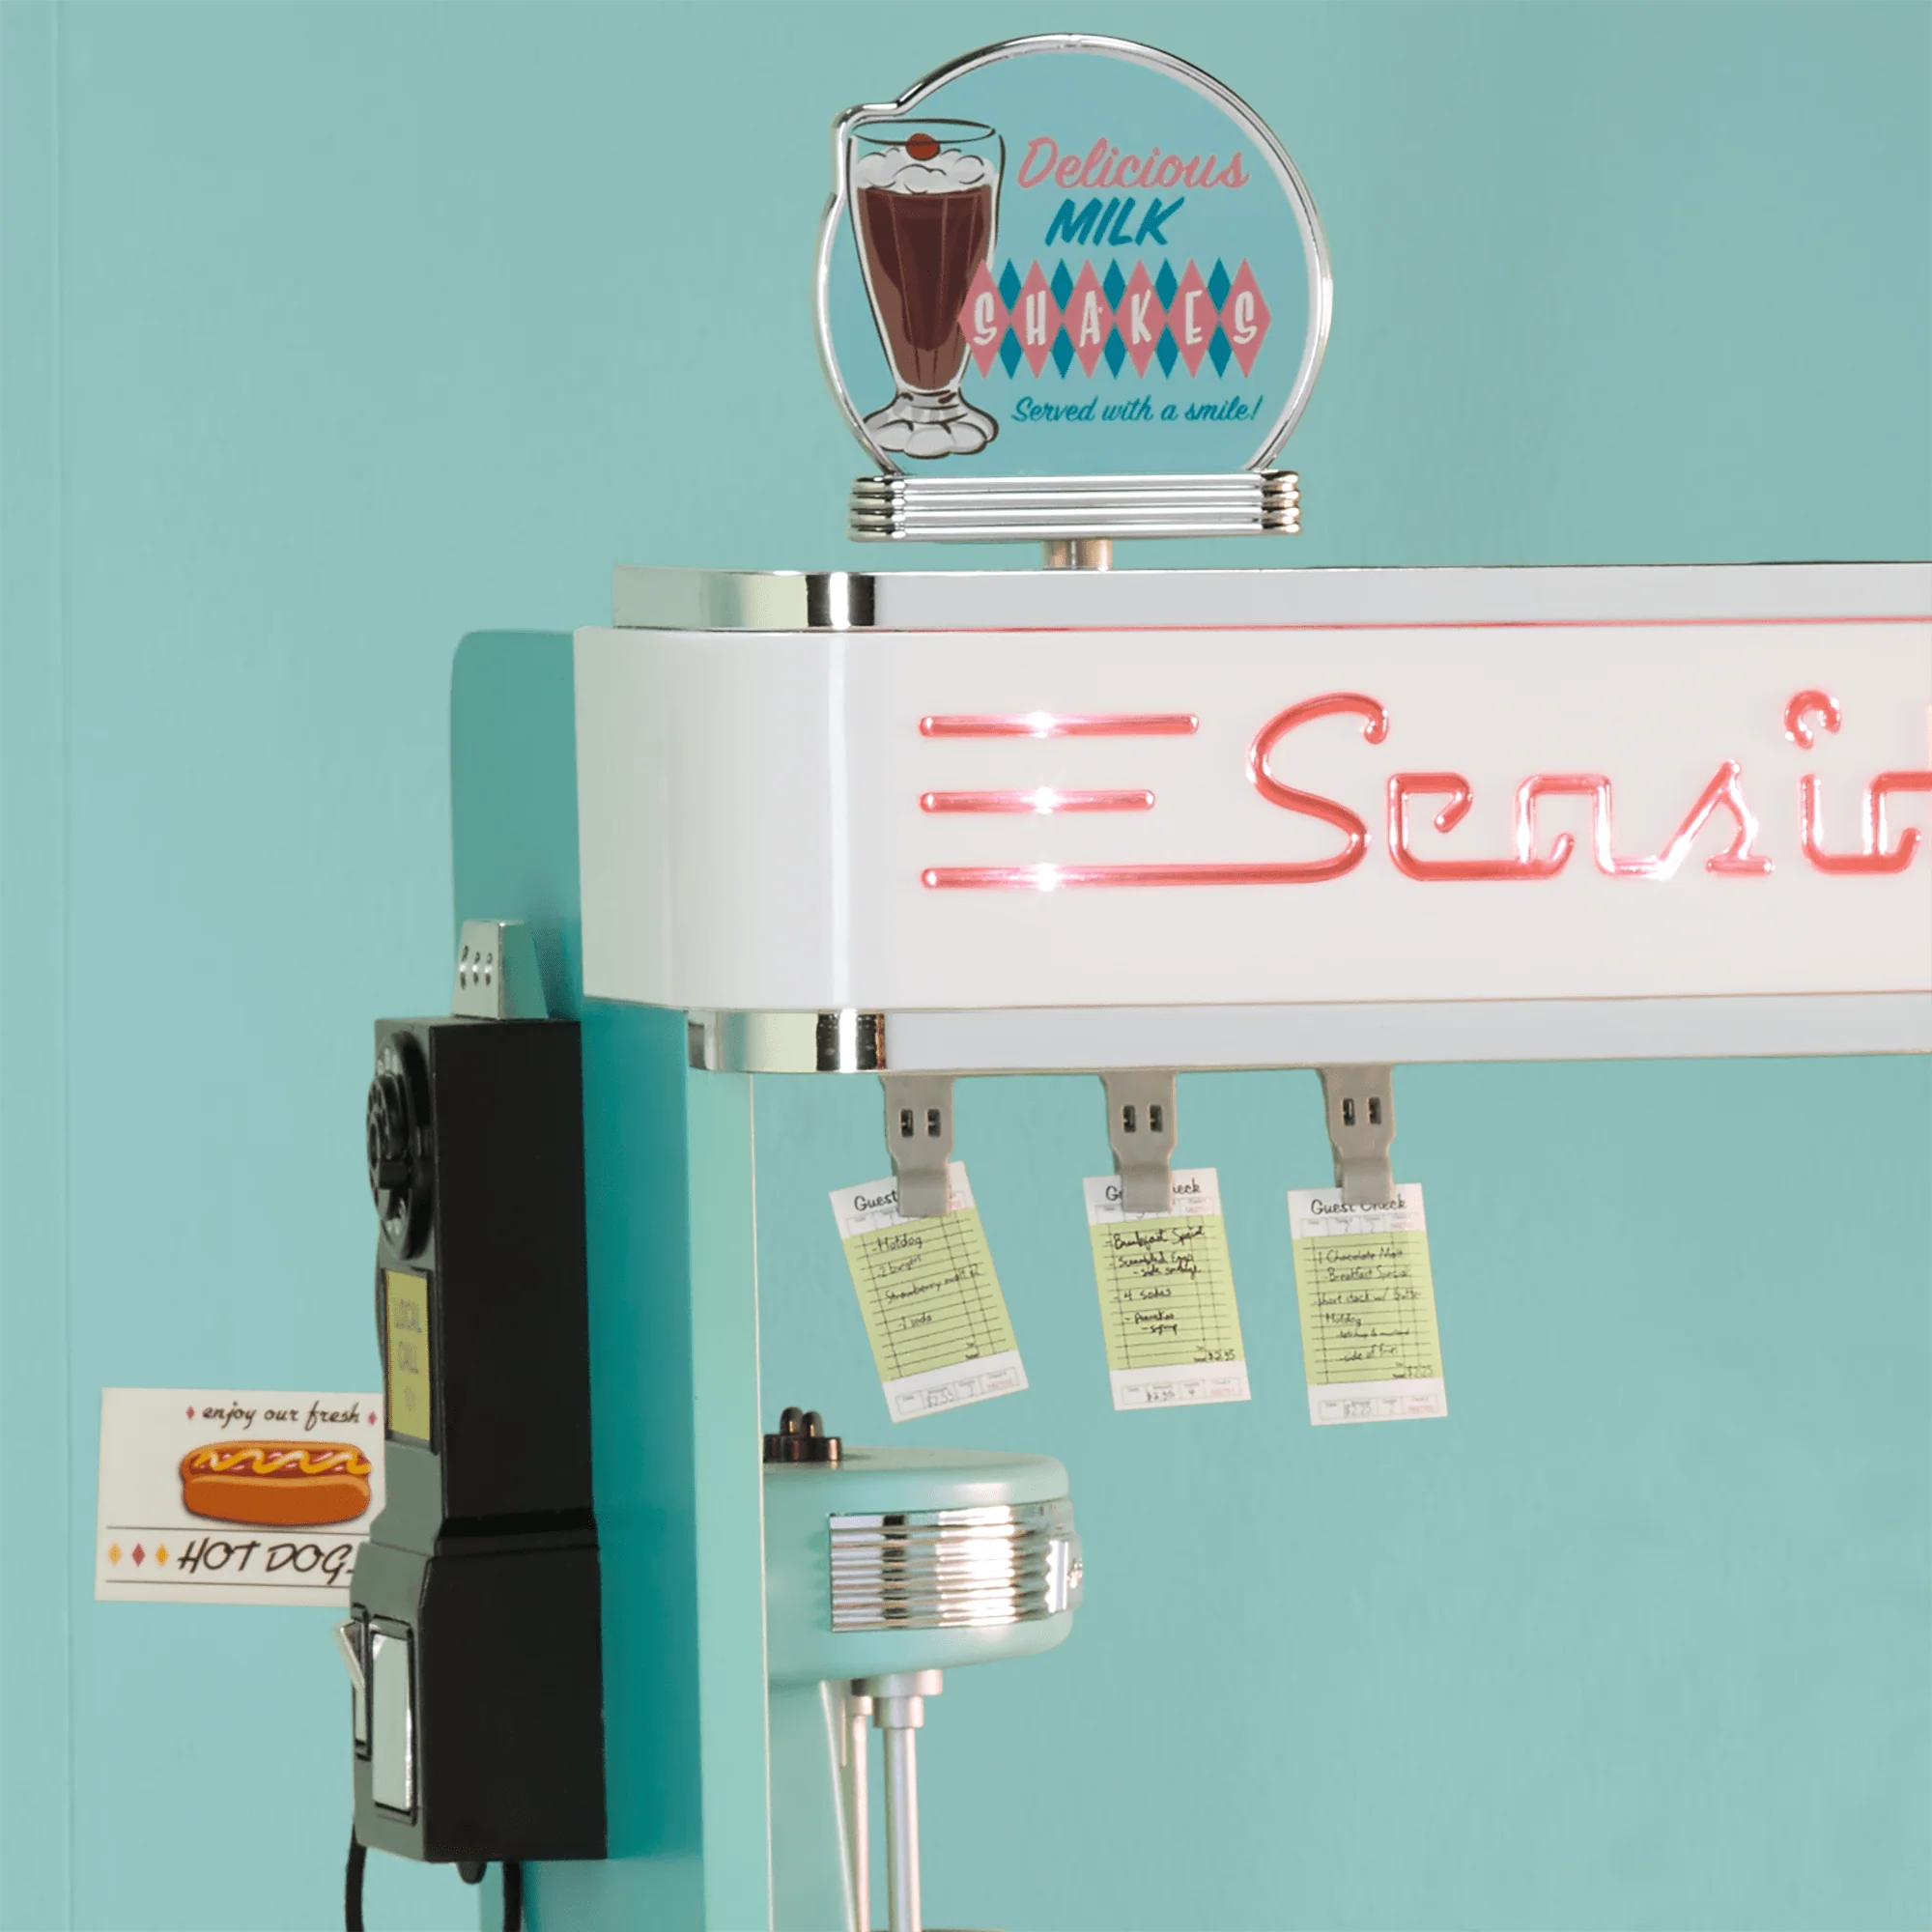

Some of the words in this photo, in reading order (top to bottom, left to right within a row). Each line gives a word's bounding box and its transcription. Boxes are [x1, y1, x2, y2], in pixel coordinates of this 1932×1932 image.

[1017, 136, 1250, 189] Delicious
[1044, 196, 1184, 246] MILK
[973, 290, 1257, 348] SHAKES
[1010, 396, 1097, 422] Served
[1101, 396, 1154, 421] with
[1160, 406, 1179, 421] a
[1183, 396, 1263, 422] smile!
[203, 1402, 257, 1430] enjoy
[264, 1410, 299, 1422] our
[305, 1401, 360, 1432] fresh
[178, 1538, 261, 1573] HOT
[265, 1542, 354, 1584] DOG
